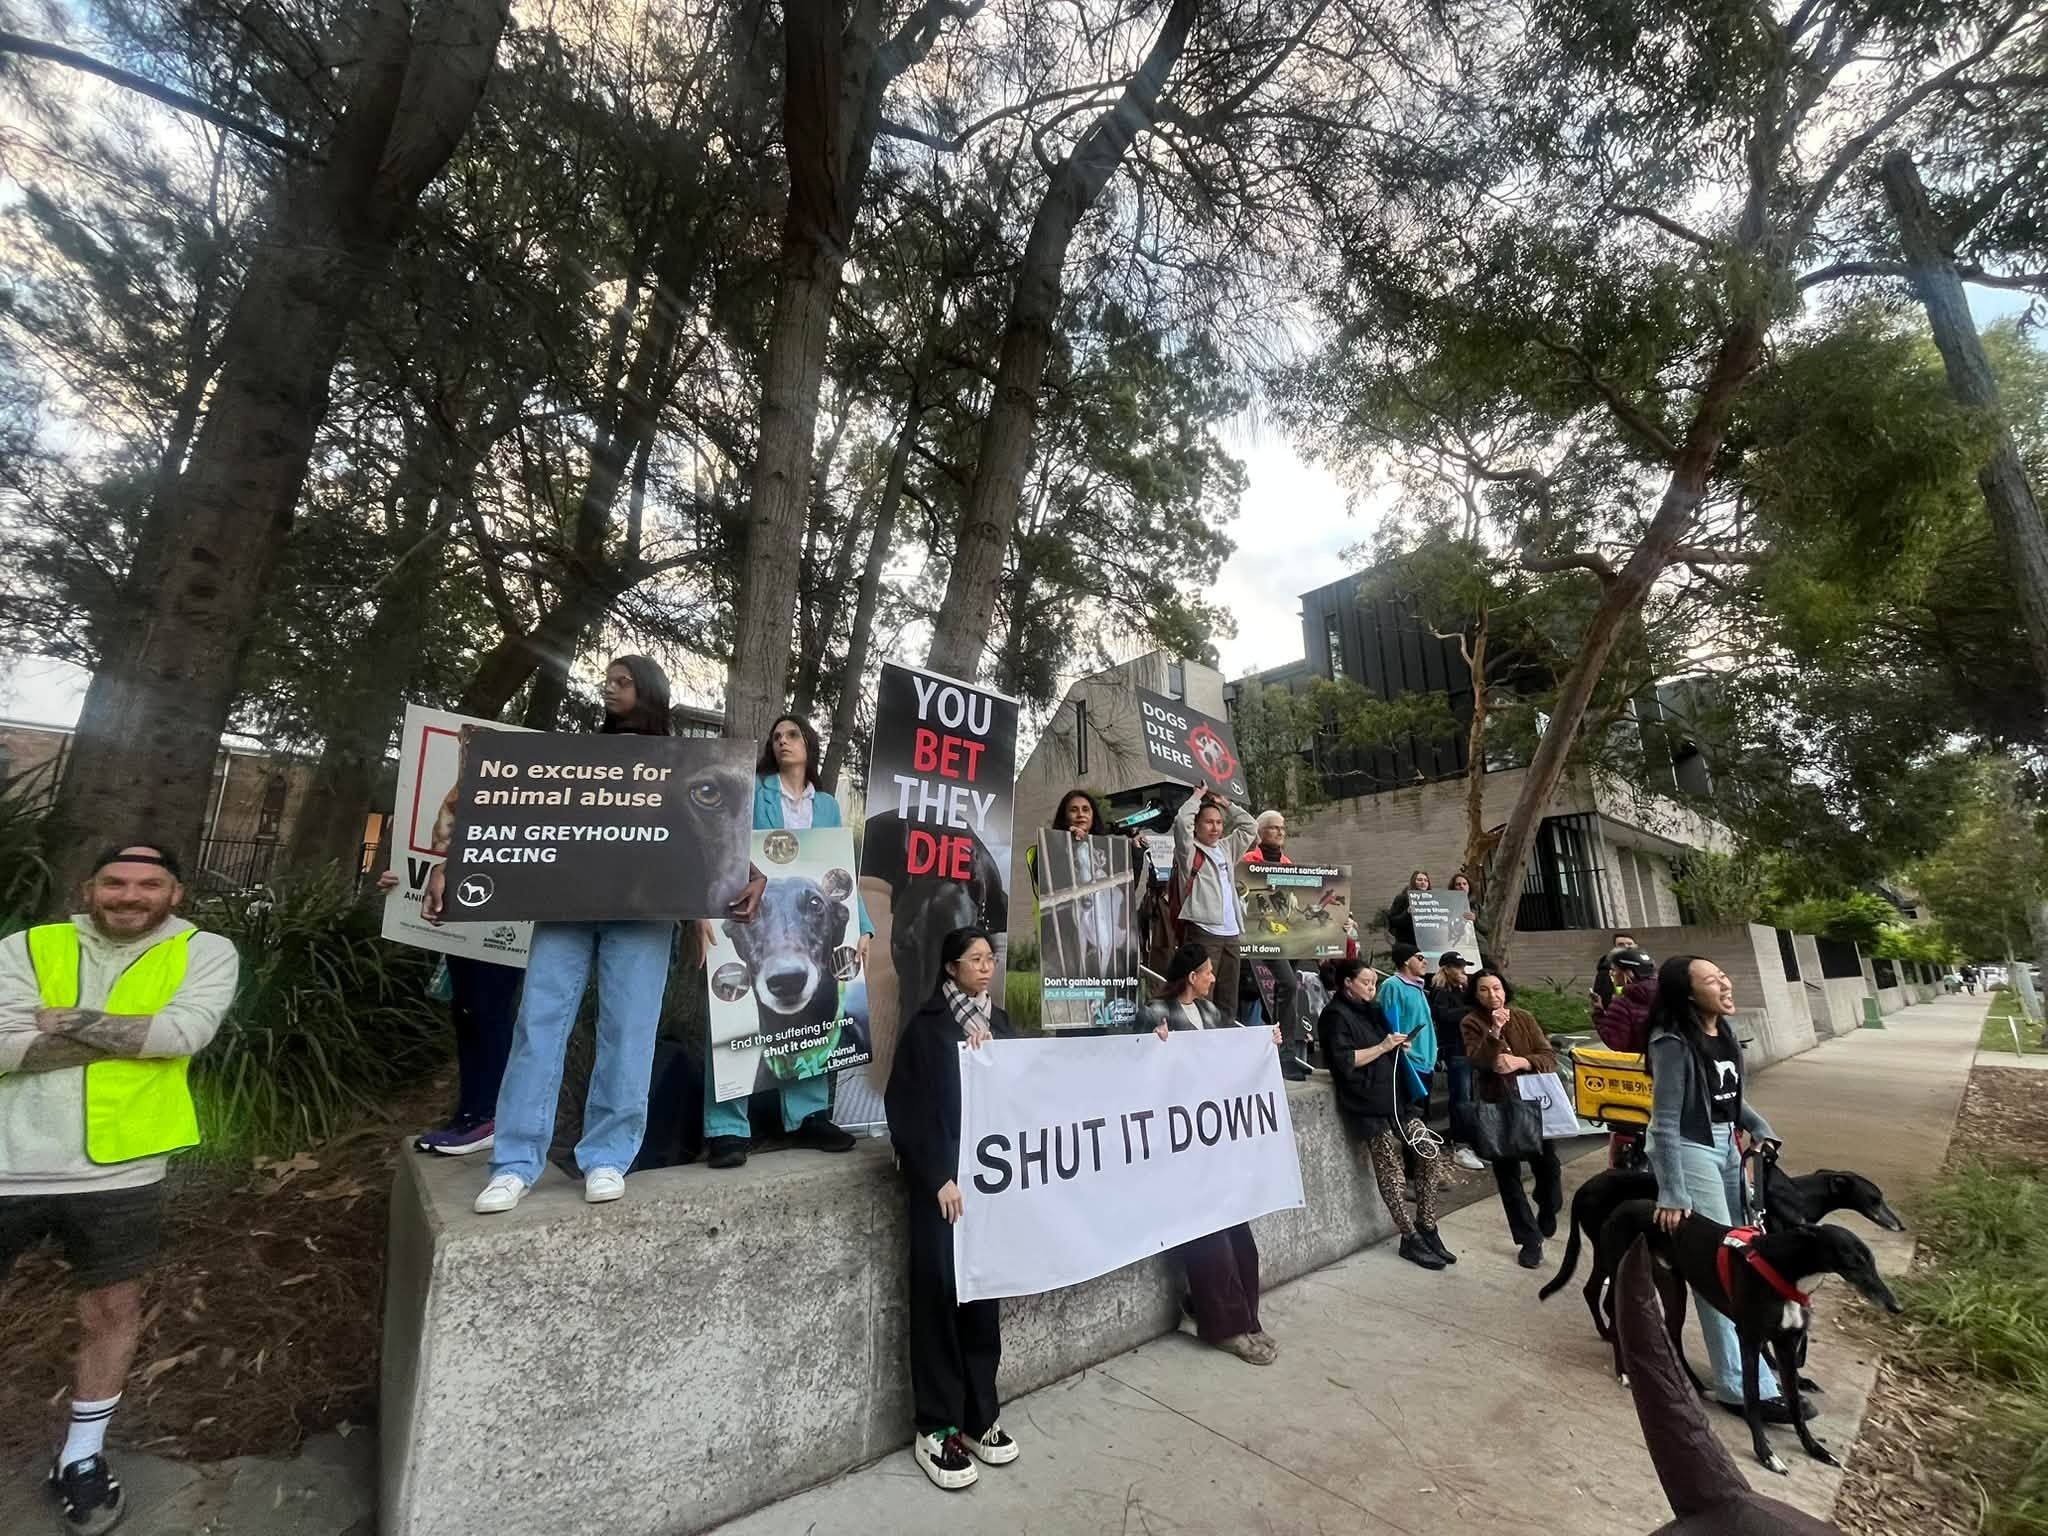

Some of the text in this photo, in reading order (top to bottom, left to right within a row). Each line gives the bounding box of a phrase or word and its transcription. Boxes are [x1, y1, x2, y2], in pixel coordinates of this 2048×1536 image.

[912, 675, 992, 736] YOU
[1142, 701, 1188, 731] DOGS
[1145, 720, 1177, 744] DIE
[913, 727, 985, 781] BET
[1149, 740, 1193, 769] HERE
[479, 760, 672, 782] No excuse for
[473, 786, 663, 807] animal abuse
[893, 774, 996, 832] THEY
[466, 825, 670, 842] BAN GREYHOUND
[462, 847, 558, 864] RACING
[907, 830, 974, 880] DIE
[1249, 864, 1339, 876] Government sanctioned
[1252, 944, 1258, 953] it
[1259, 944, 1281, 953] down
[1044, 977, 1068, 987] Don't
[1068, 976, 1101, 989] gamble
[1101, 978, 1112, 987] on
[1112, 978, 1126, 989] my
[730, 1016, 854, 1051] End the suffering for me
[763, 1036, 829, 1058] shut it down
[827, 1043, 856, 1058] Animal
[827, 1051, 869, 1069] Liberation
[973, 1091, 1279, 1195] SHUT IT DOWN
